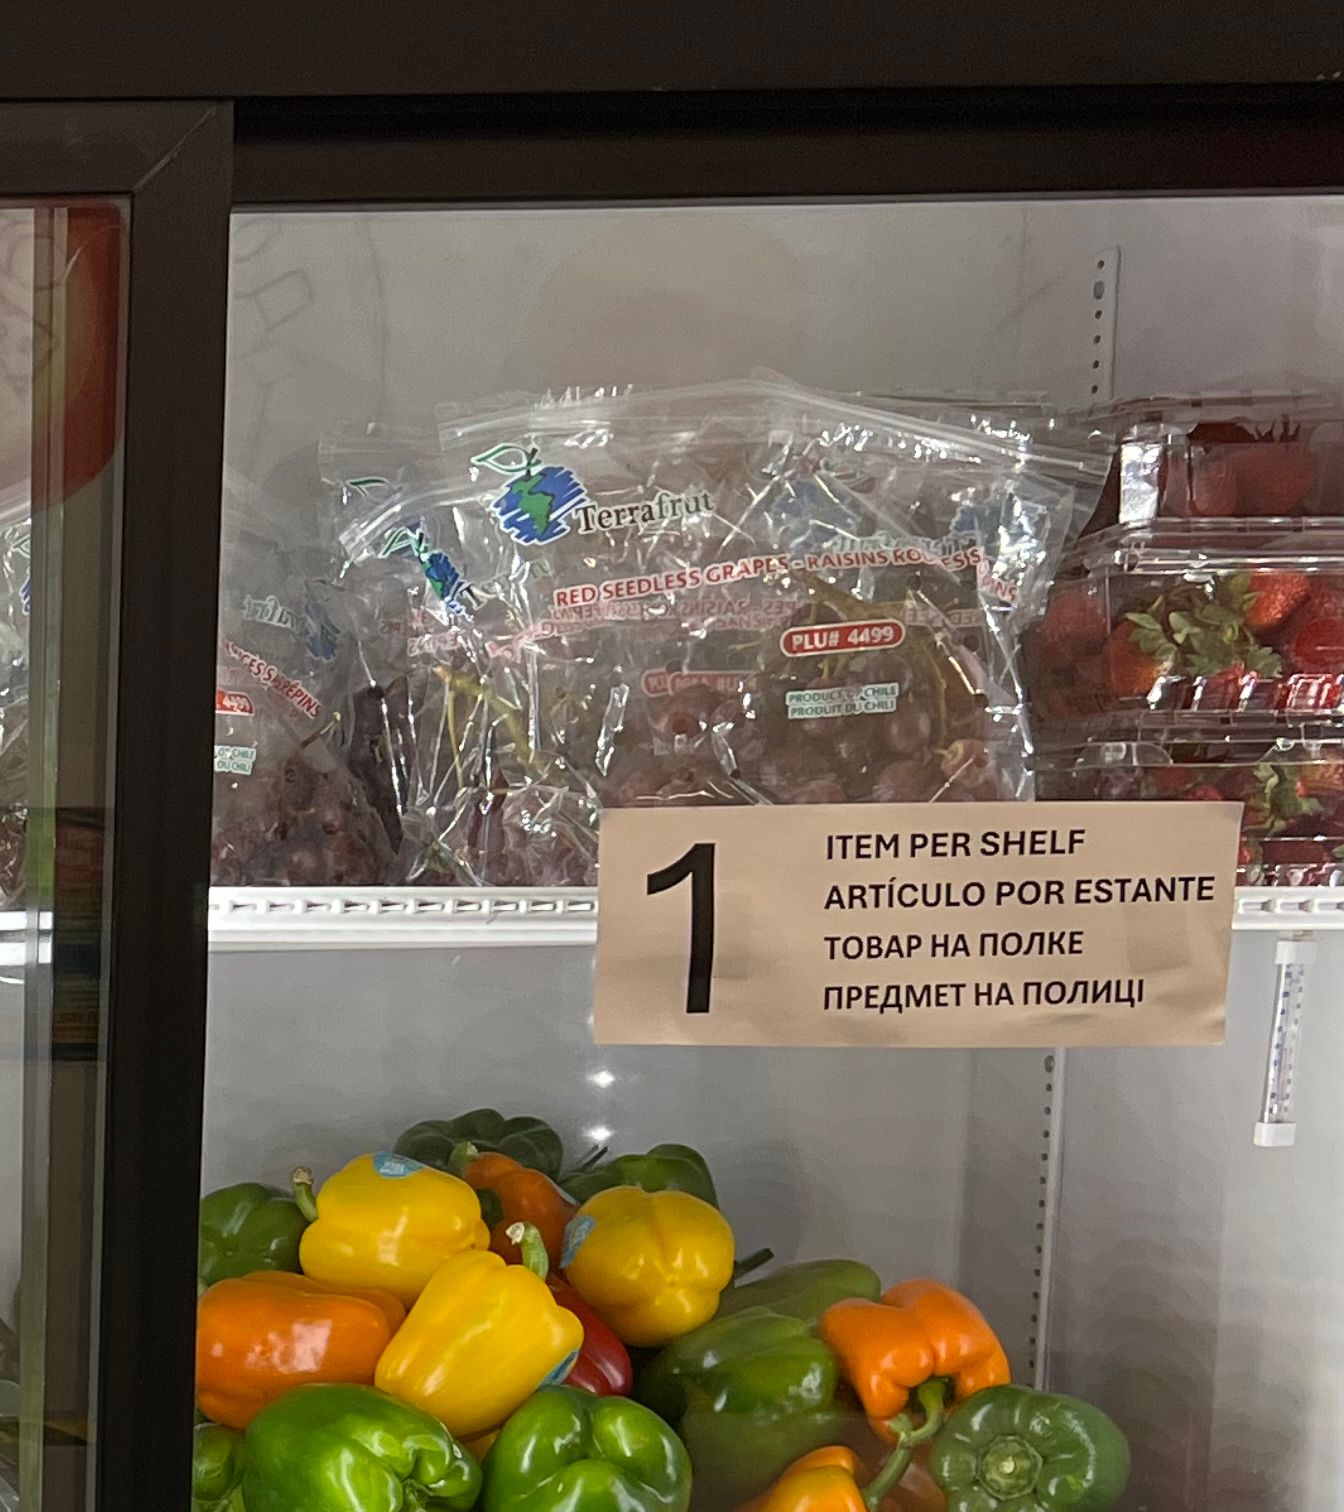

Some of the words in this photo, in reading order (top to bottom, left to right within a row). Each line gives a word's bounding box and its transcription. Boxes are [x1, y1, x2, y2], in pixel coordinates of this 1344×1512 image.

[575, 491, 714, 533] Terrafrut
[556, 586, 597, 607] RED
[603, 570, 701, 600] SEEDLESS
[706, 554, 788, 584] GRAPES
[808, 551, 888, 569] RAISINS
[792, 634, 840, 651] PLU#
[848, 626, 896, 644] 4499
[864, 684, 898, 696] CHILE
[791, 703, 842, 716] PRODUIT
[846, 702, 861, 713] DU
[864, 700, 895, 711] CHILI
[827, 834, 901, 860] ITEM
[911, 832, 972, 858] PER
[980, 829, 1087, 856] SHELF
[825, 876, 986, 911] ARTÍCULO
[996, 879, 1065, 906] POR
[1074, 876, 1216, 904] ESTANTE
[646, 842, 716, 1014] 1
[825, 934, 922, 960] ТОВАР
[931, 933, 971, 958] НА
[979, 931, 1084, 957] ПОЛКЕ
[823, 982, 965, 1015] ПРЕДМЕТ
[975, 982, 1015, 1007] НА
[1023, 979, 1145, 1009] ПОЛИЦІ
